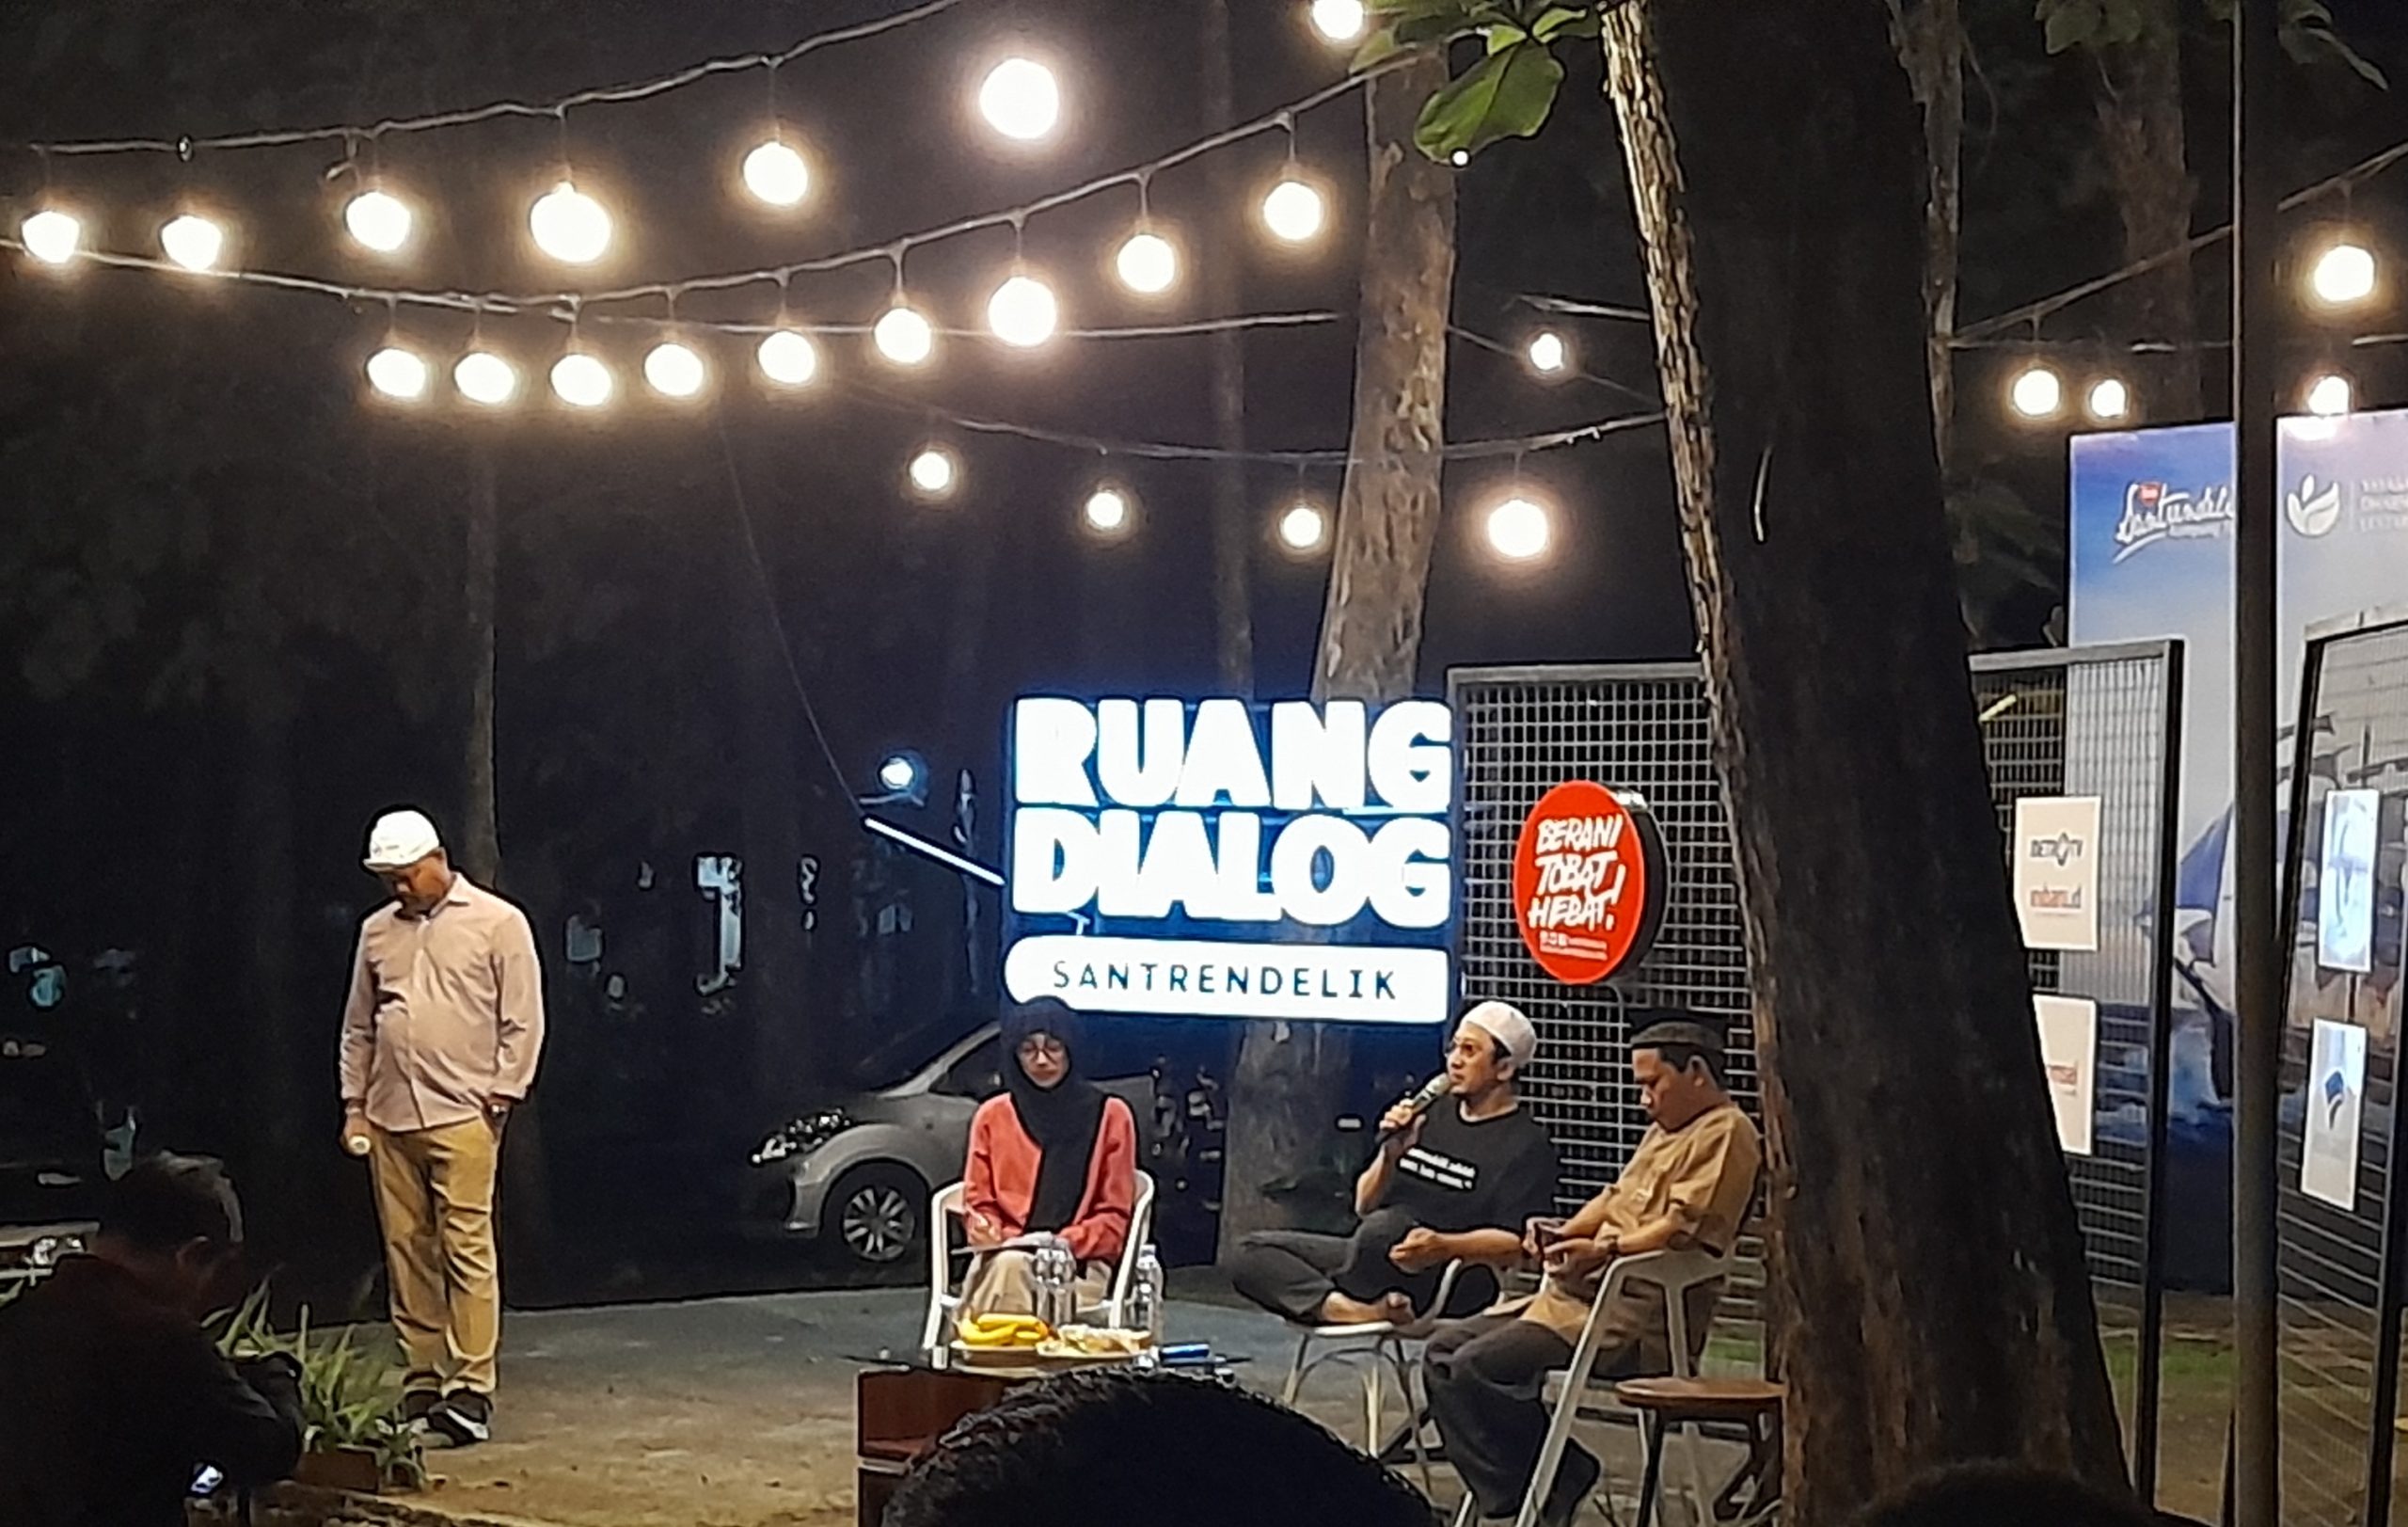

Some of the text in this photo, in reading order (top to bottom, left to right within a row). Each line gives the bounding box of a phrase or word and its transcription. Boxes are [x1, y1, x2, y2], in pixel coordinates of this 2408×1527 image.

[1015, 698, 1451, 811] RUANG
[1536, 814, 1624, 854] BERANI
[1013, 807, 1451, 928] DIALOG
[1534, 850, 1618, 896] TOBAT
[1054, 960, 1396, 1000] SANTRENDELIK
